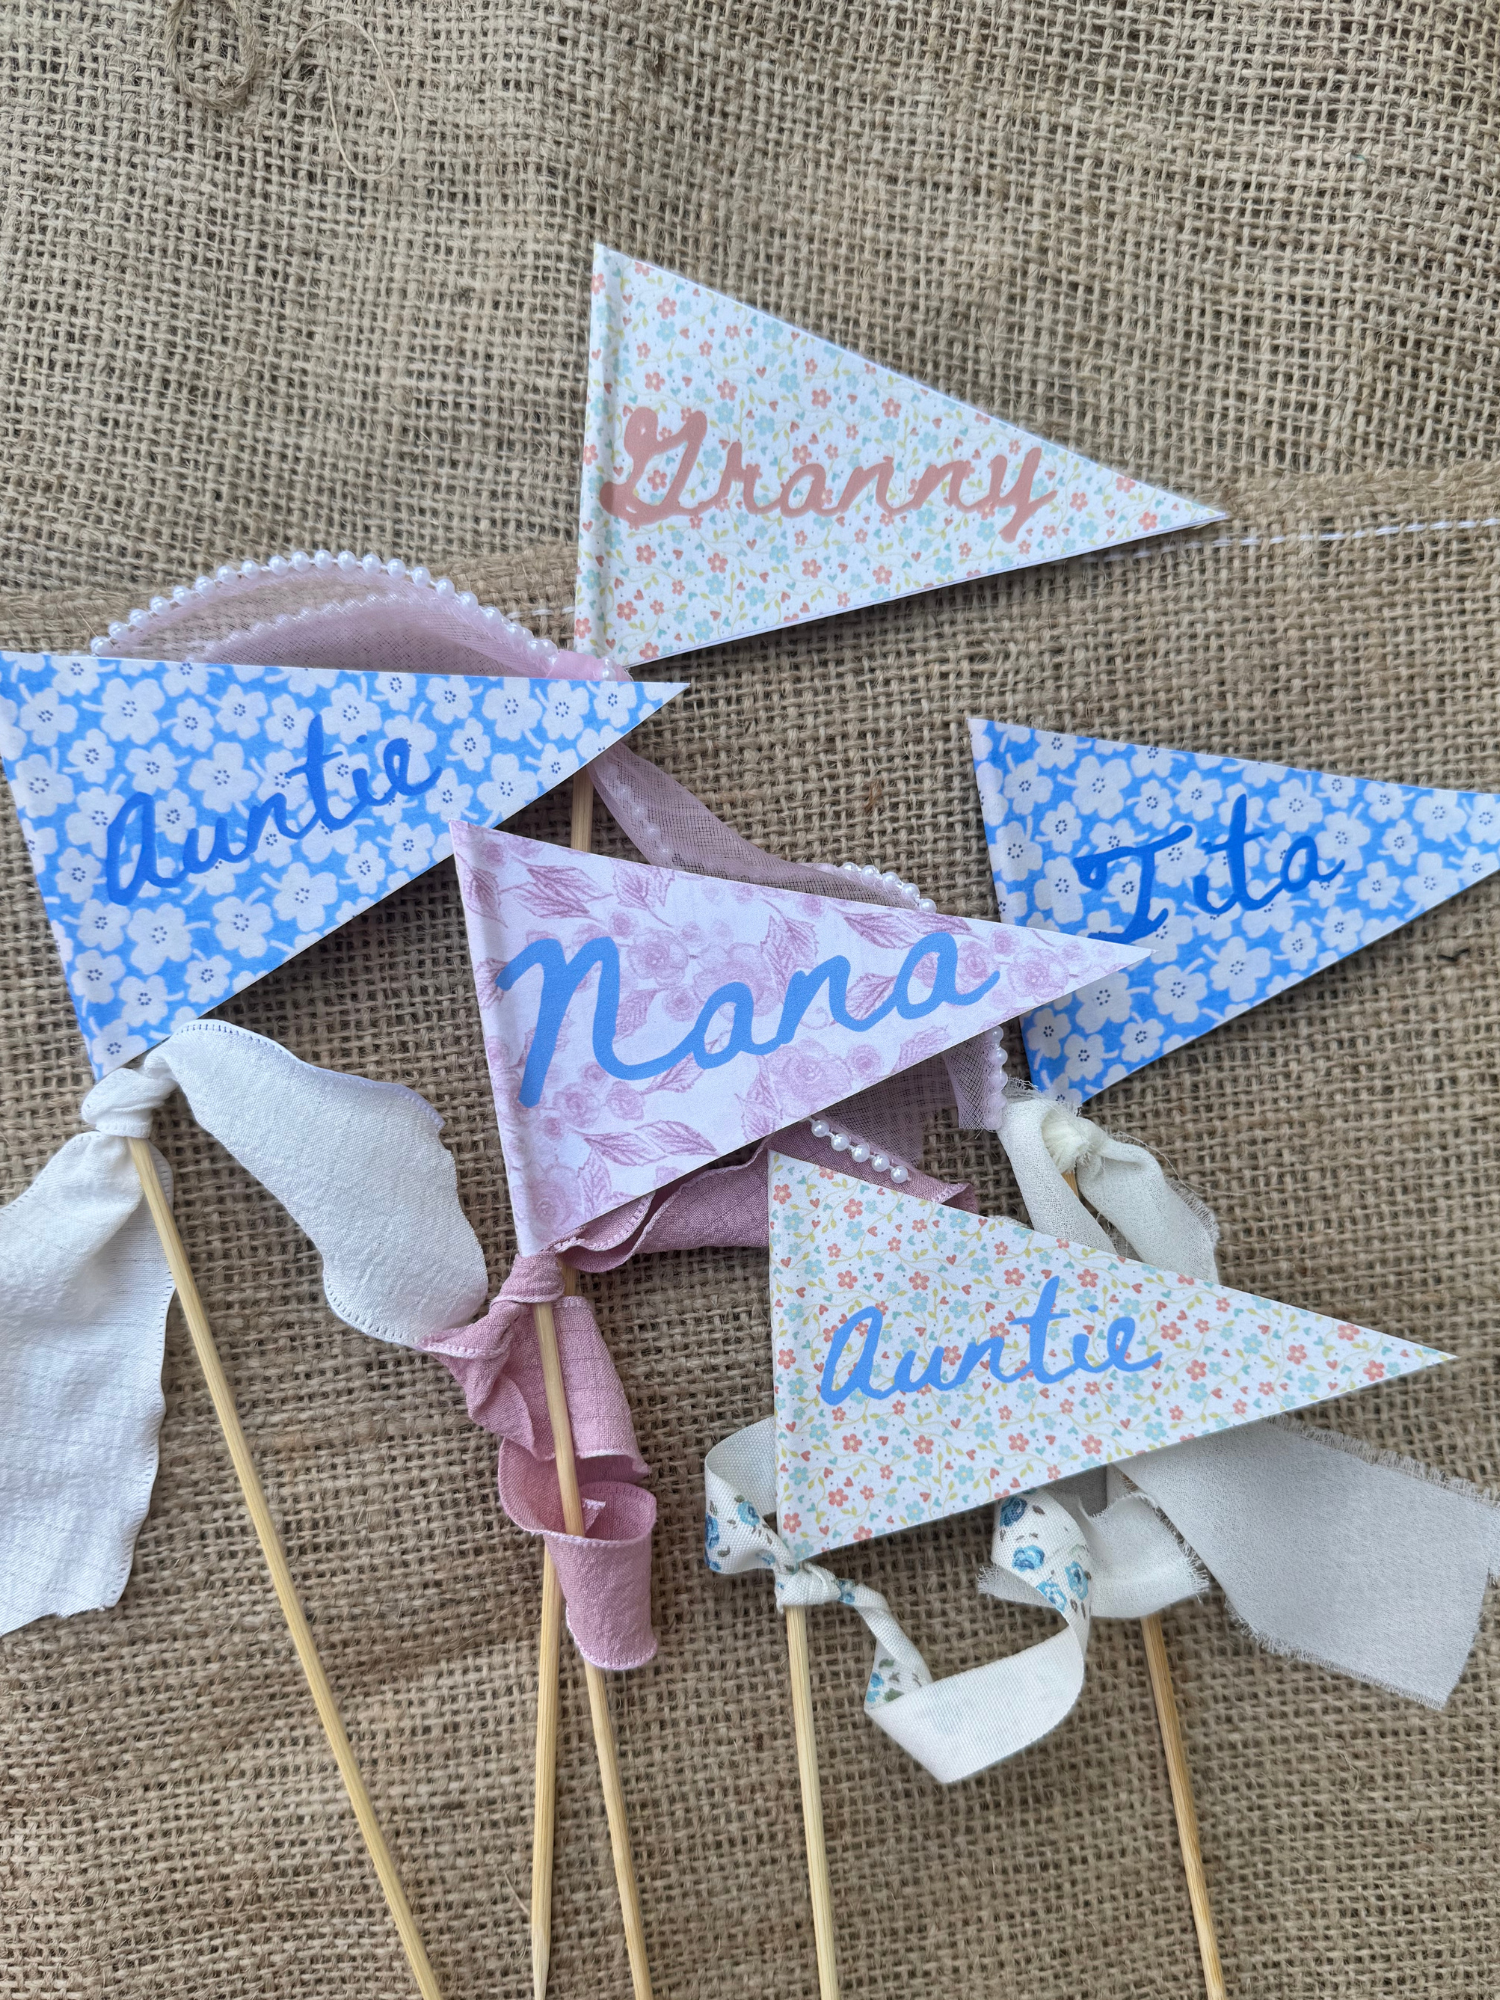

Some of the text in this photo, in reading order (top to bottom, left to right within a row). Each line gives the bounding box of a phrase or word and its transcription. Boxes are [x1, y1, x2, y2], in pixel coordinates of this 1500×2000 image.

[601, 406, 1059, 543] Granny
[106, 713, 443, 906] Auntie
[1073, 793, 1346, 944] Tita
[495, 931, 1001, 1109] Nana
[820, 1275, 1163, 1406] Auntie
